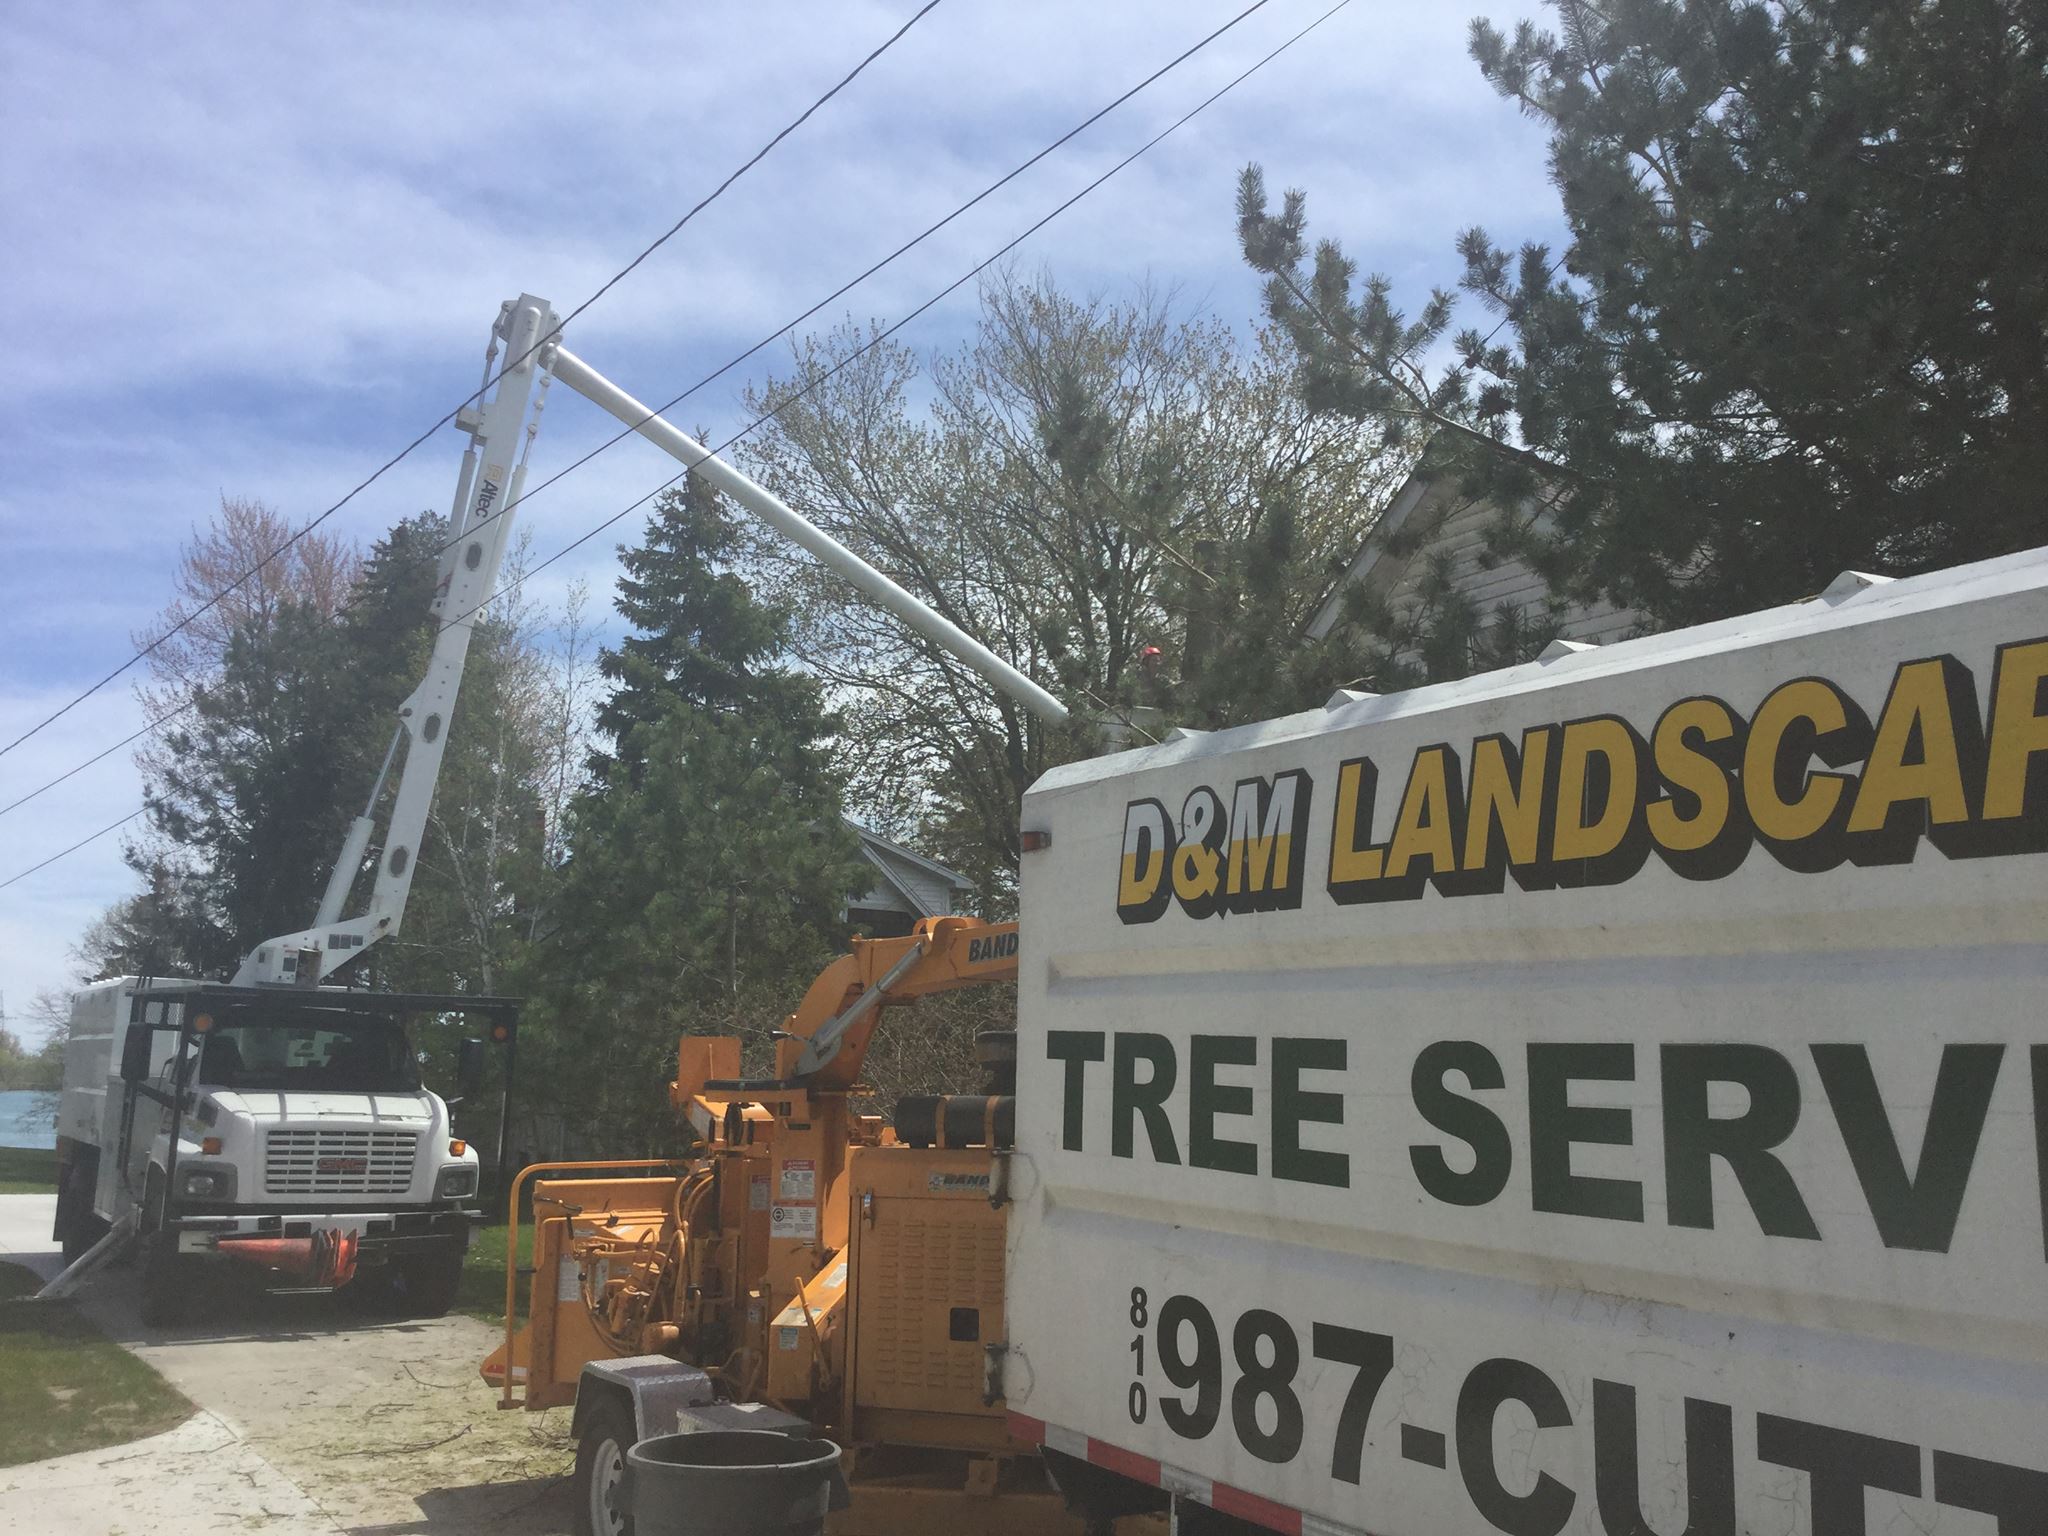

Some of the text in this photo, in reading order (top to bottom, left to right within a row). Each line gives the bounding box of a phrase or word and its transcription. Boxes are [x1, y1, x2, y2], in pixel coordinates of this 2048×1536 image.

[475, 479, 499, 518] Altec
[1116, 767, 1313, 924] D&M
[968, 932, 1019, 962] BAND
[1047, 1030, 2048, 1264] TREE SERV
